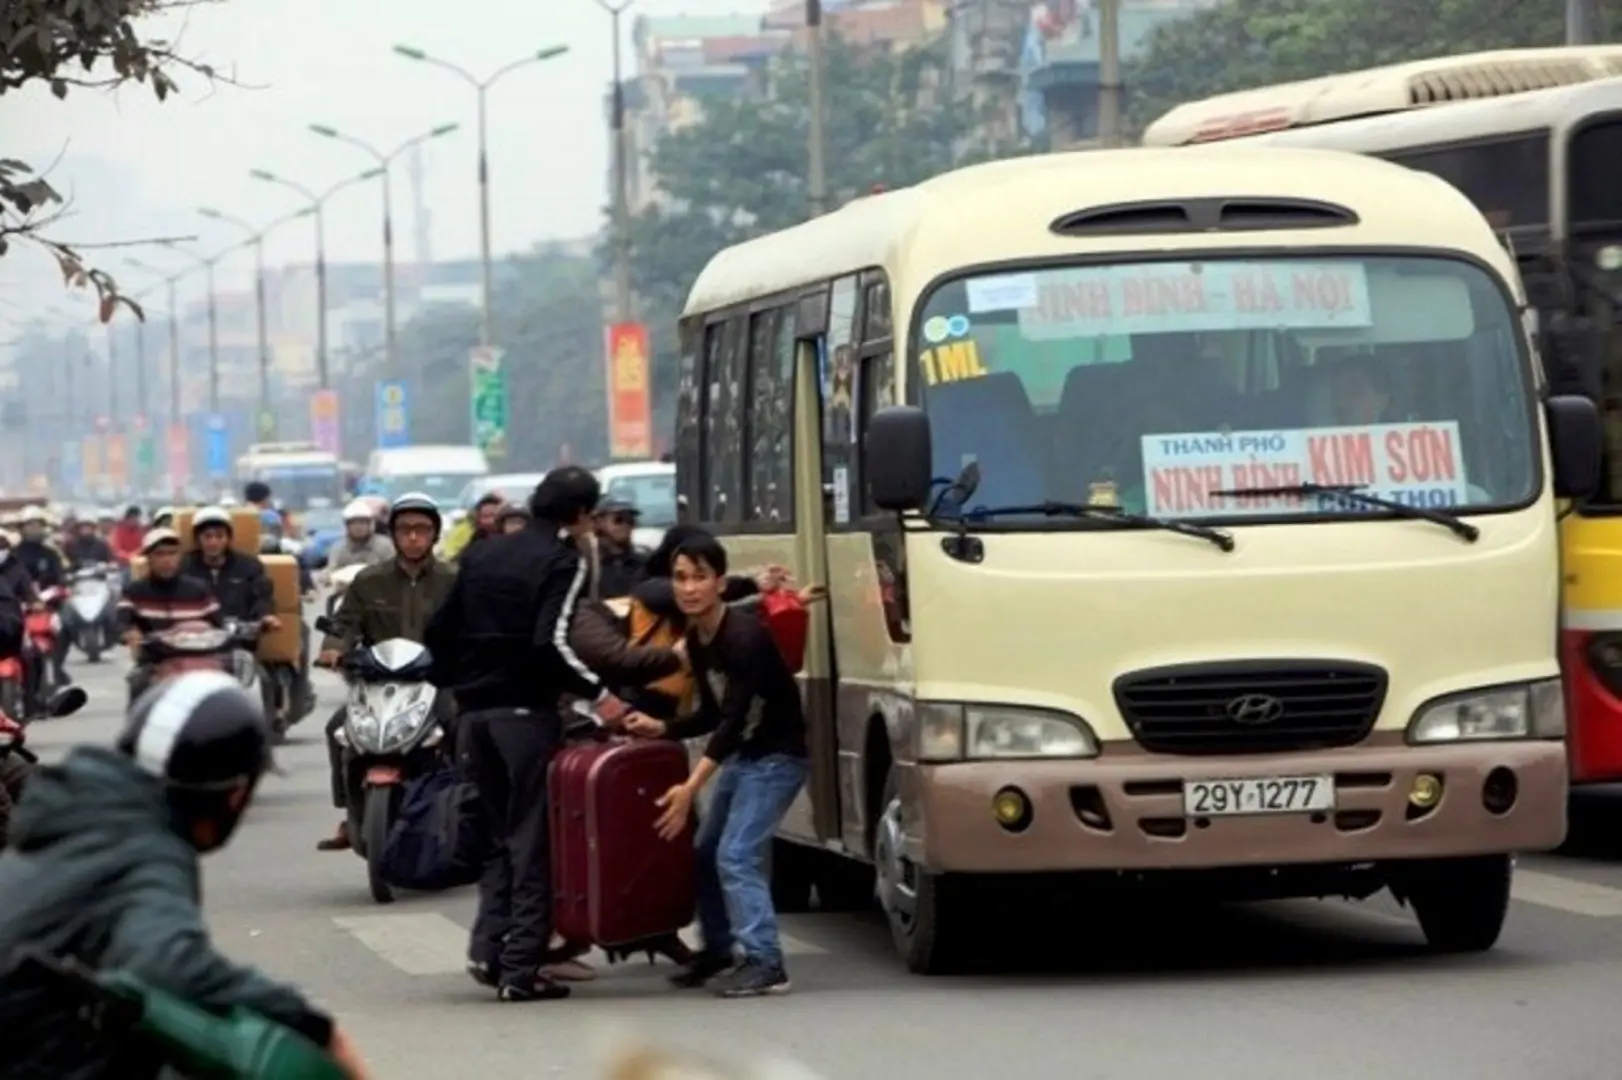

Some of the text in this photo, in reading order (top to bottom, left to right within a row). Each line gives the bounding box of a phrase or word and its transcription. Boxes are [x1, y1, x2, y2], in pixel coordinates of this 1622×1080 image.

[919, 340, 988, 386] 1ML
[1308, 425, 1456, 486] KIM SƠN
[1152, 465, 1226, 512] NINH
[1193, 779, 1317, 812] 29Y-1277
